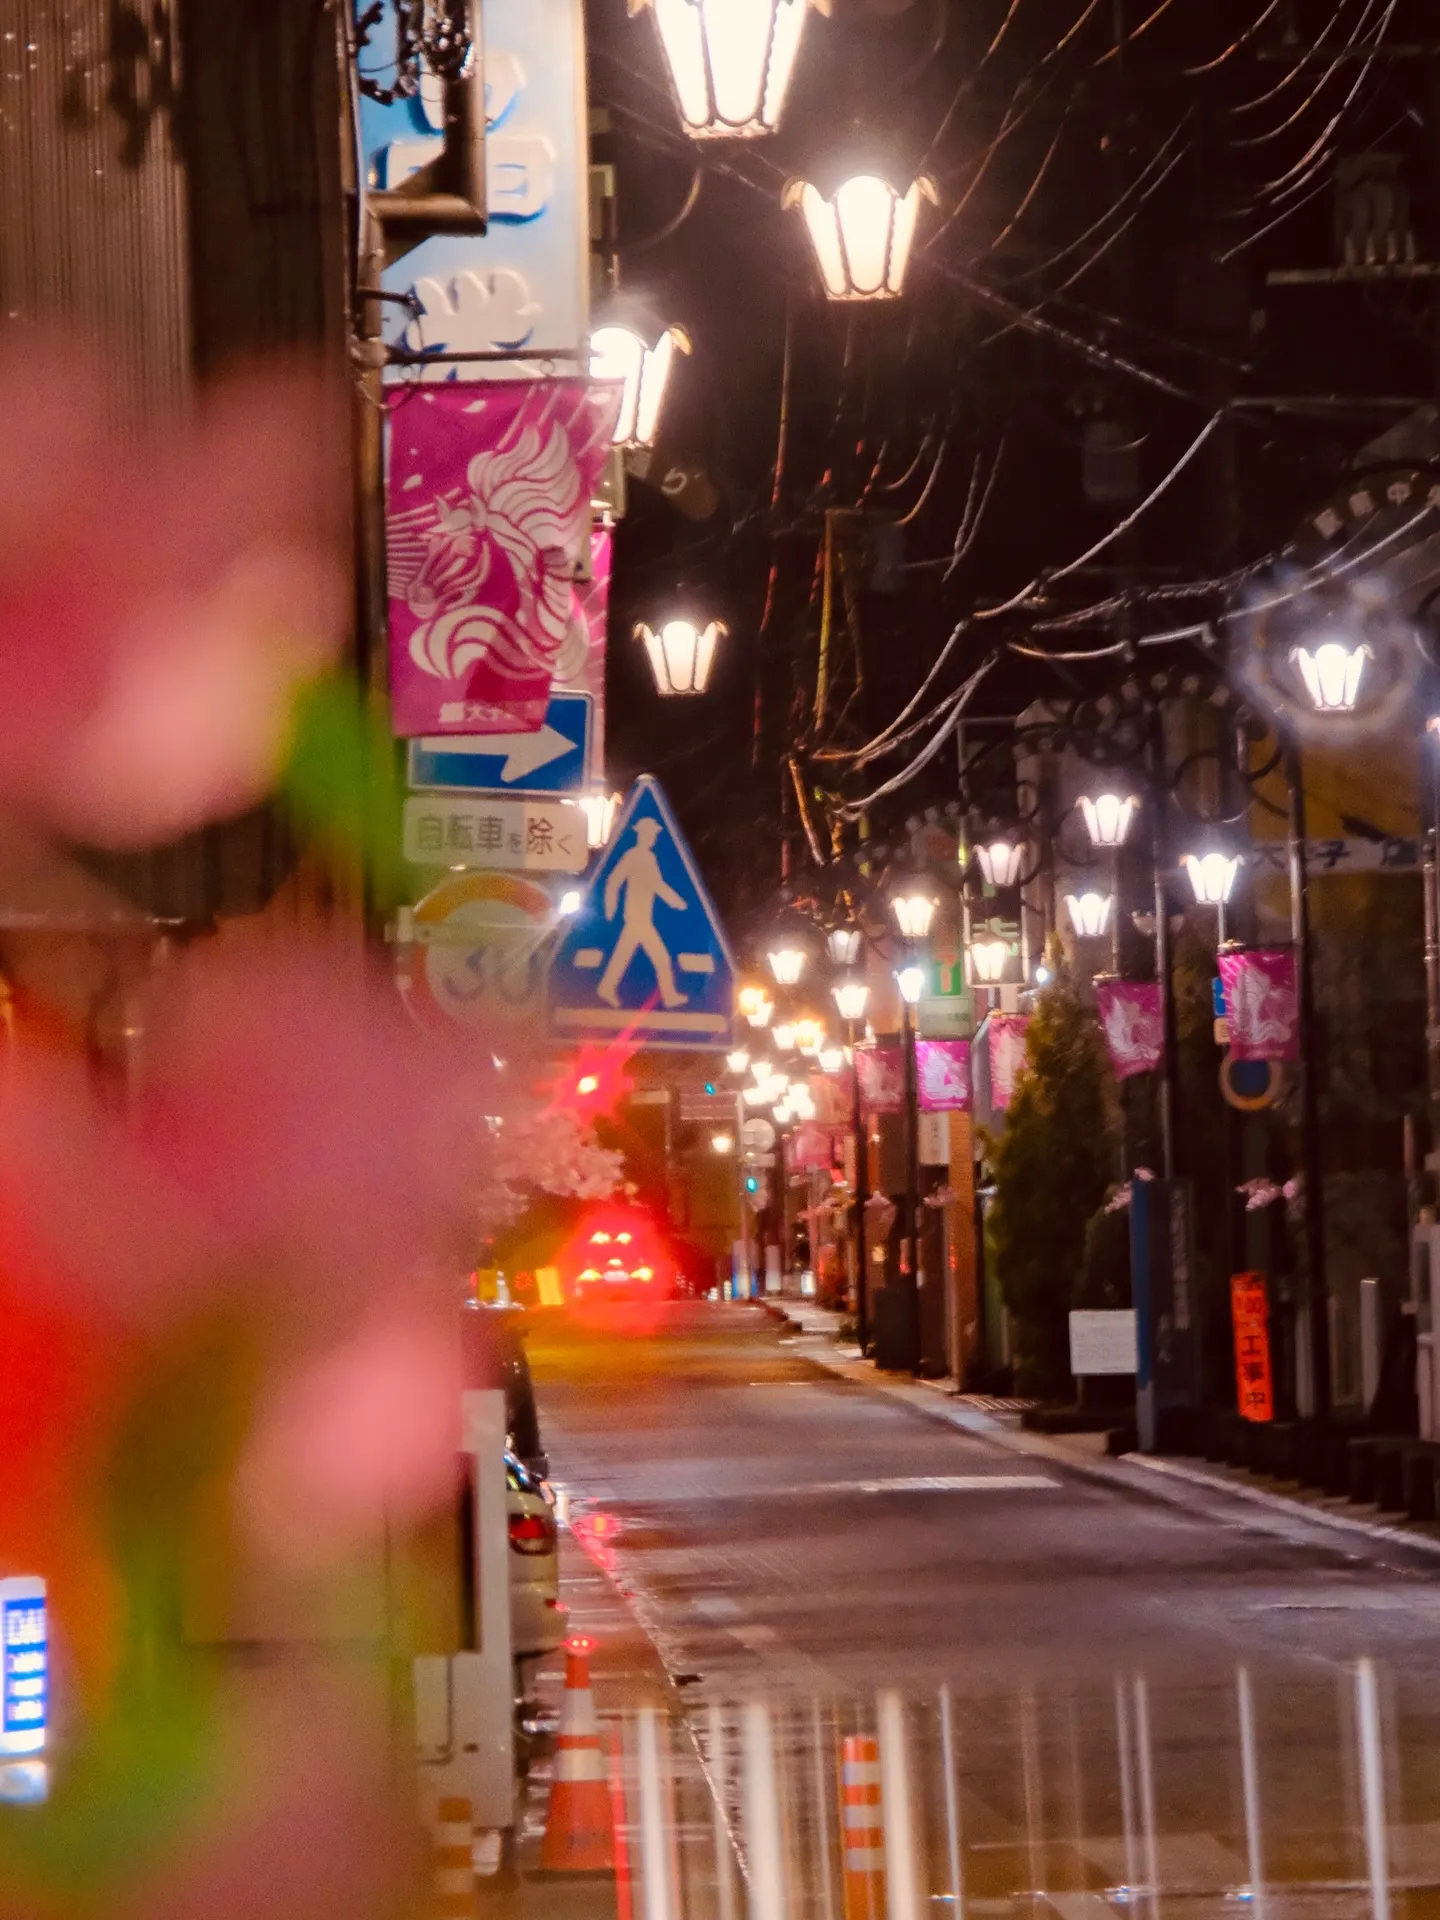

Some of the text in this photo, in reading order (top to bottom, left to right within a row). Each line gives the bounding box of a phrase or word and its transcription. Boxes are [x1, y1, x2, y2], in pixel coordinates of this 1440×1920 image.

[417, 815, 573, 855] 自転車を除く
